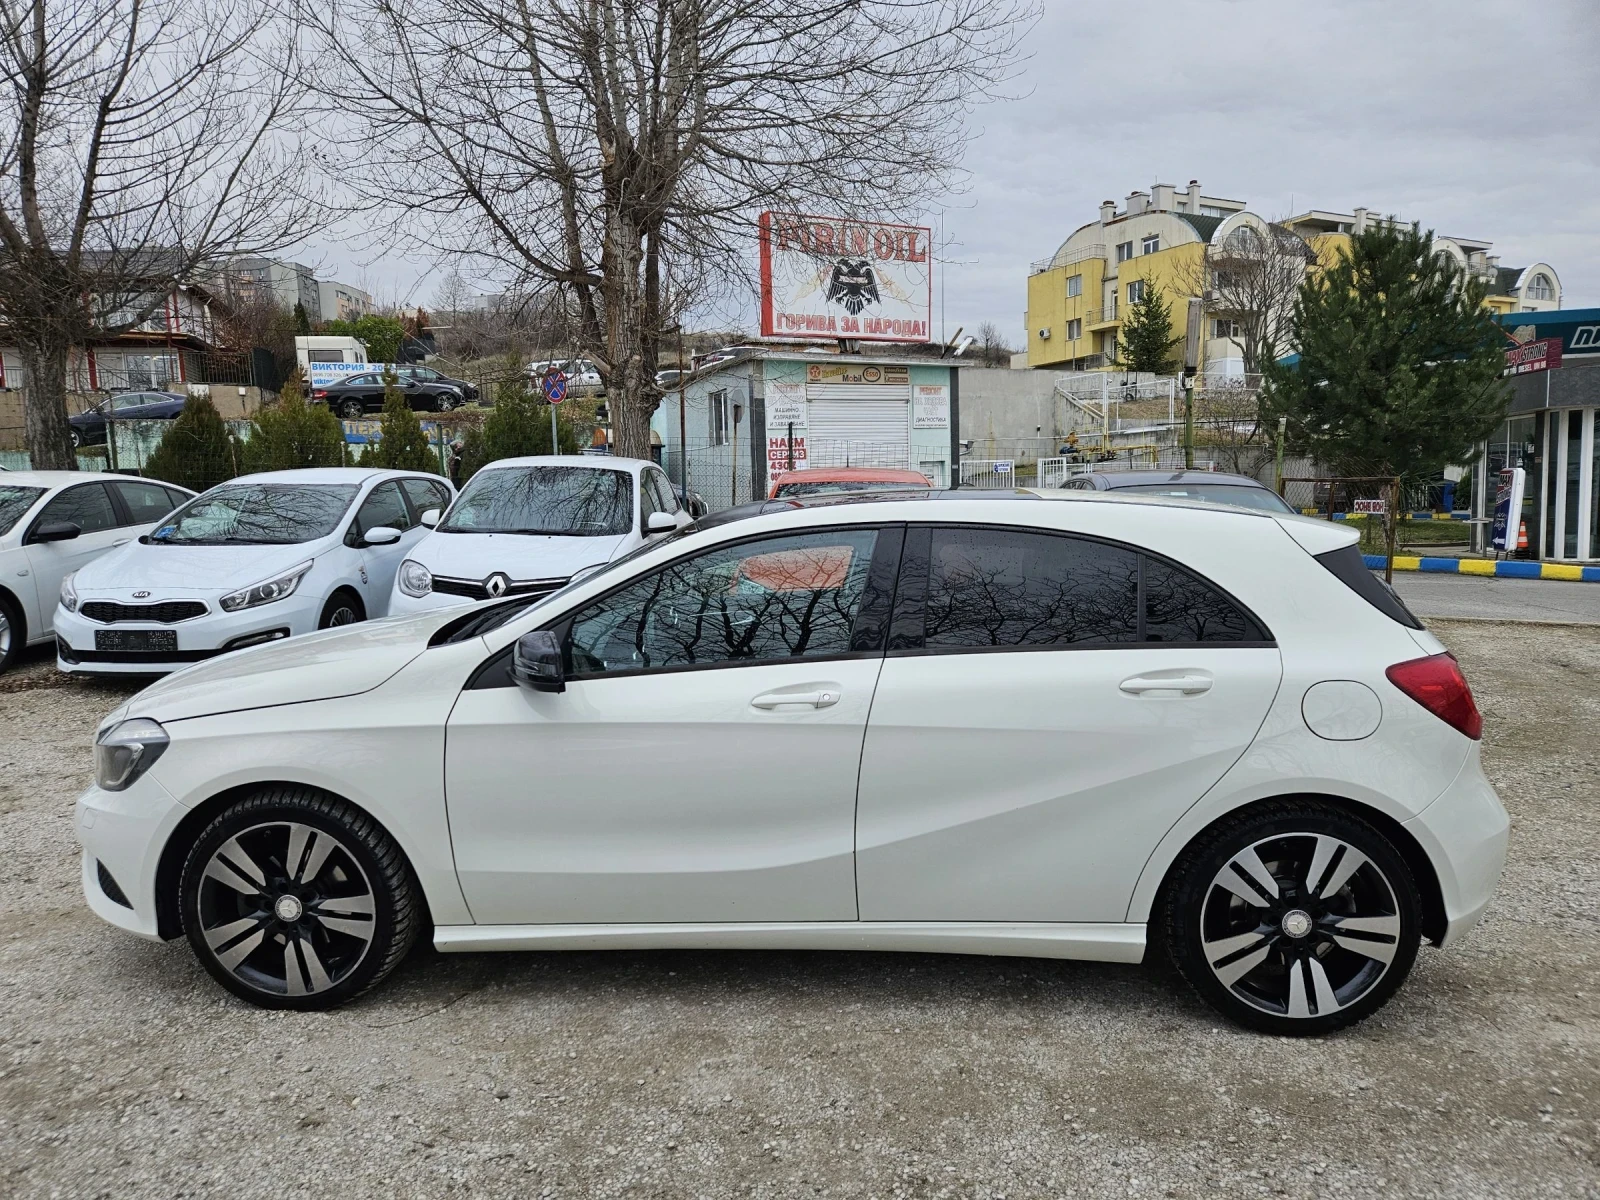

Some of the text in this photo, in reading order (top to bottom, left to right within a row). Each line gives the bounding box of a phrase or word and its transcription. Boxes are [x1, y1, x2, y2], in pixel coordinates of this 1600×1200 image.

[776, 219, 926, 263] PIRIN OIL
[776, 312, 926, 337] ГОРИВА ЗА НАРОДА!
[312, 363, 364, 371] ВИКТОРИЯ
[842, 374, 862, 382] Mobil
[865, 370, 878, 378] Esso
